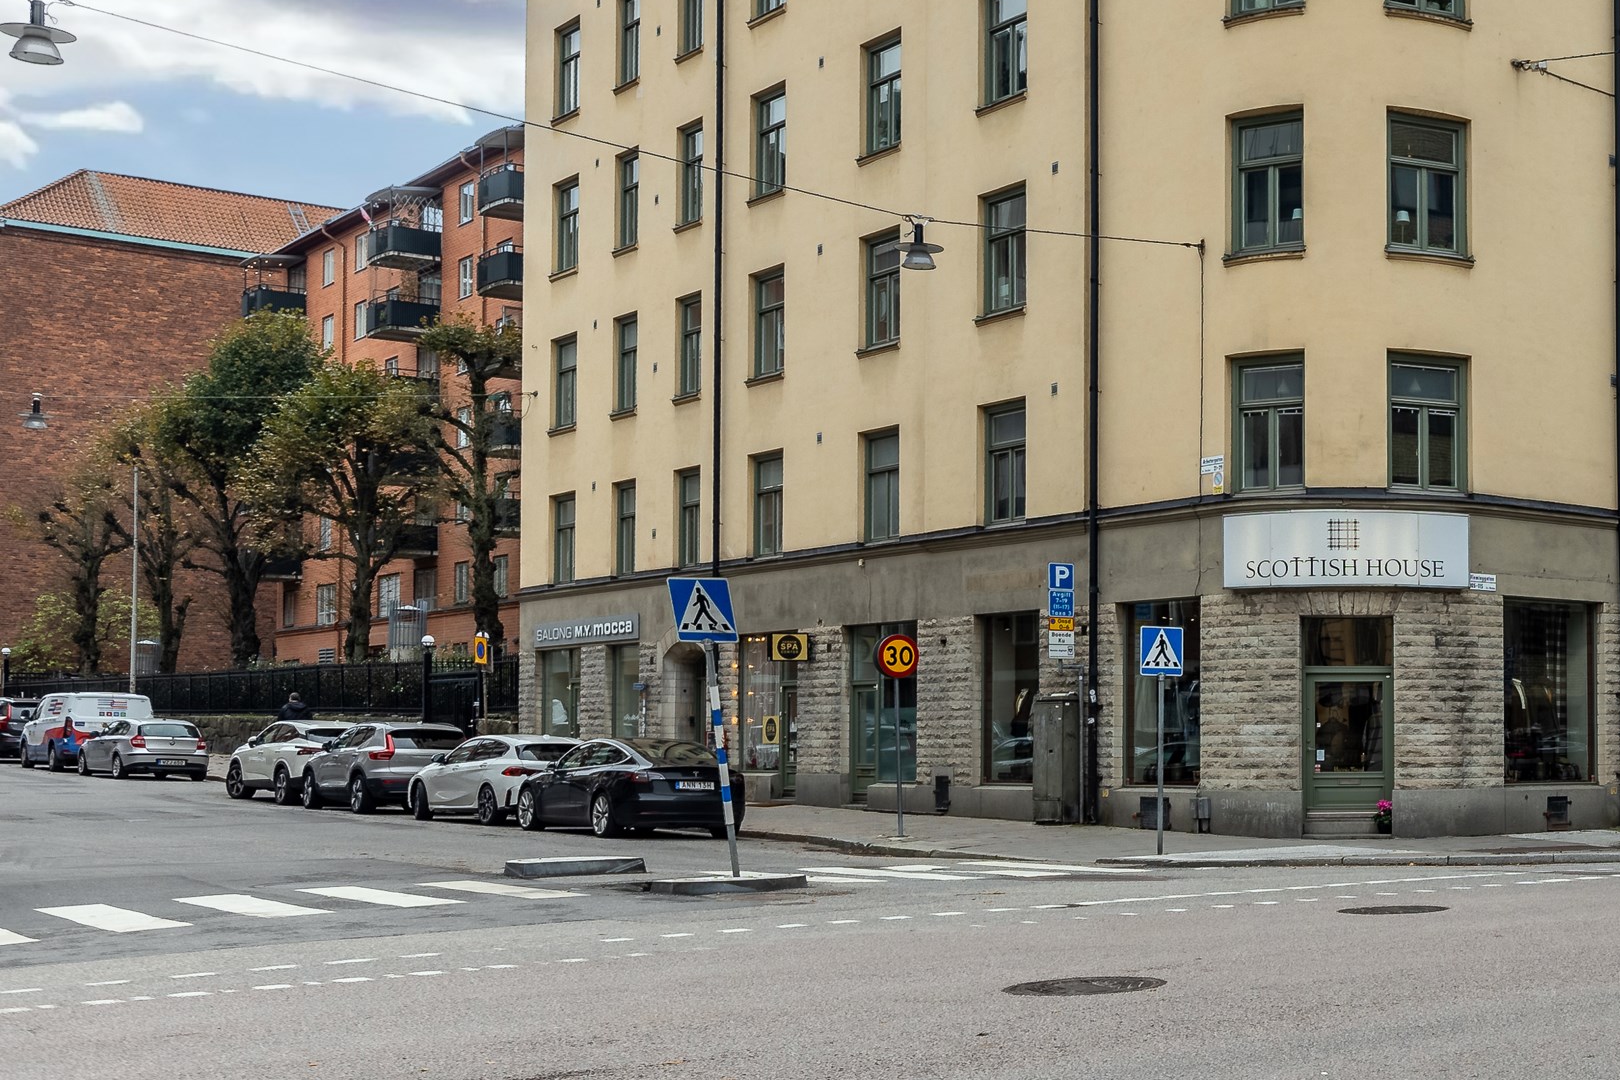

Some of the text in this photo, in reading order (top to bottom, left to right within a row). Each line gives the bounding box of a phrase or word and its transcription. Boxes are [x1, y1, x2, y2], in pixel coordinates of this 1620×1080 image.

[1055, 565, 1070, 587] P
[1246, 557, 1445, 579] SCOTTISH HOUSE
[1052, 591, 1071, 599] Avgift
[536, 620, 633, 641] SALONG M.Y. mocca
[780, 643, 799, 651] SPA
[886, 645, 914, 667] 30
